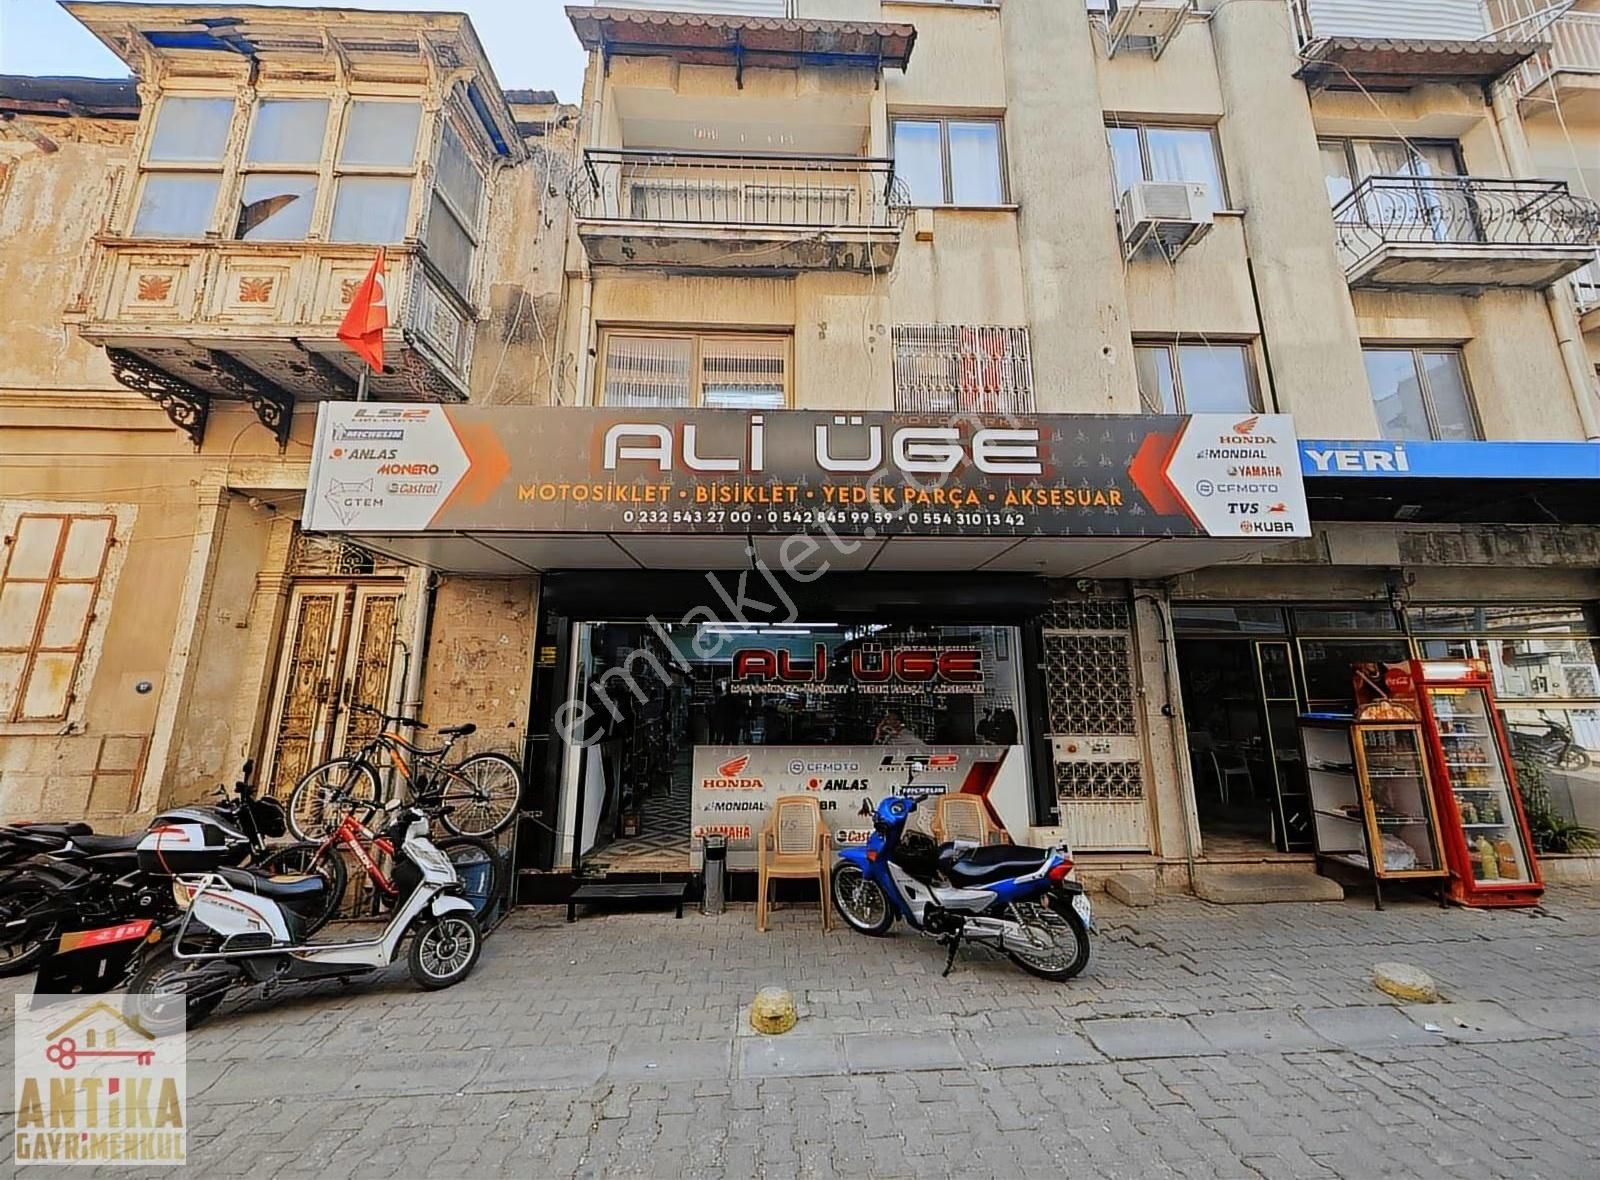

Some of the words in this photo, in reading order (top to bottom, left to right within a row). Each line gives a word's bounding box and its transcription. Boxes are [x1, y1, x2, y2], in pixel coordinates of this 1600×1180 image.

[354, 408, 431, 418] LS2
[603, 415, 764, 471] ALİ
[816, 415, 1043, 474] ÜGE
[1219, 436, 1278, 444] HONDA
[348, 448, 398, 460] ANLAS
[1209, 449, 1268, 459] MONDIAL
[1305, 446, 1410, 471] YERİ
[377, 464, 439, 475] MONERO
[1239, 465, 1283, 476] YAMAHA
[399, 483, 438, 494] Castrol
[1216, 484, 1278, 493] CFMOTO
[518, 482, 672, 502] MOTOSİKLET
[696, 483, 798, 504] BİSİKLET
[822, 486, 897, 505] YEDEK
[903, 487, 981, 508] PARÇA
[1004, 489, 1124, 507] AKSESUAR
[344, 498, 384, 507] GTEM
[1227, 503, 1260, 514] TVS
[624, 511, 634, 523] 0
[638, 511, 668, 523] 232
[673, 511, 702, 523] 543
[707, 512, 725, 523] 27
[730, 512, 751, 523] 00
[768, 512, 778, 523] 0
[783, 512, 812, 523] 542
[817, 512, 846, 523] 845
[851, 512, 869, 523] 99
[874, 513, 892, 524] 59
[908, 513, 918, 524] 0
[923, 513, 951, 525] 554
[957, 514, 981, 525] 310
[986, 514, 1000, 525] 13
[1005, 514, 1025, 526] 42
[852, 643, 984, 682] ÜGE
[880, 755, 959, 766] LS2
[807, 762, 859, 771] CFMOTO
[703, 779, 763, 789] HONDA
[823, 779, 869, 790] ANLAS
[714, 801, 765, 811] MONDIAL
